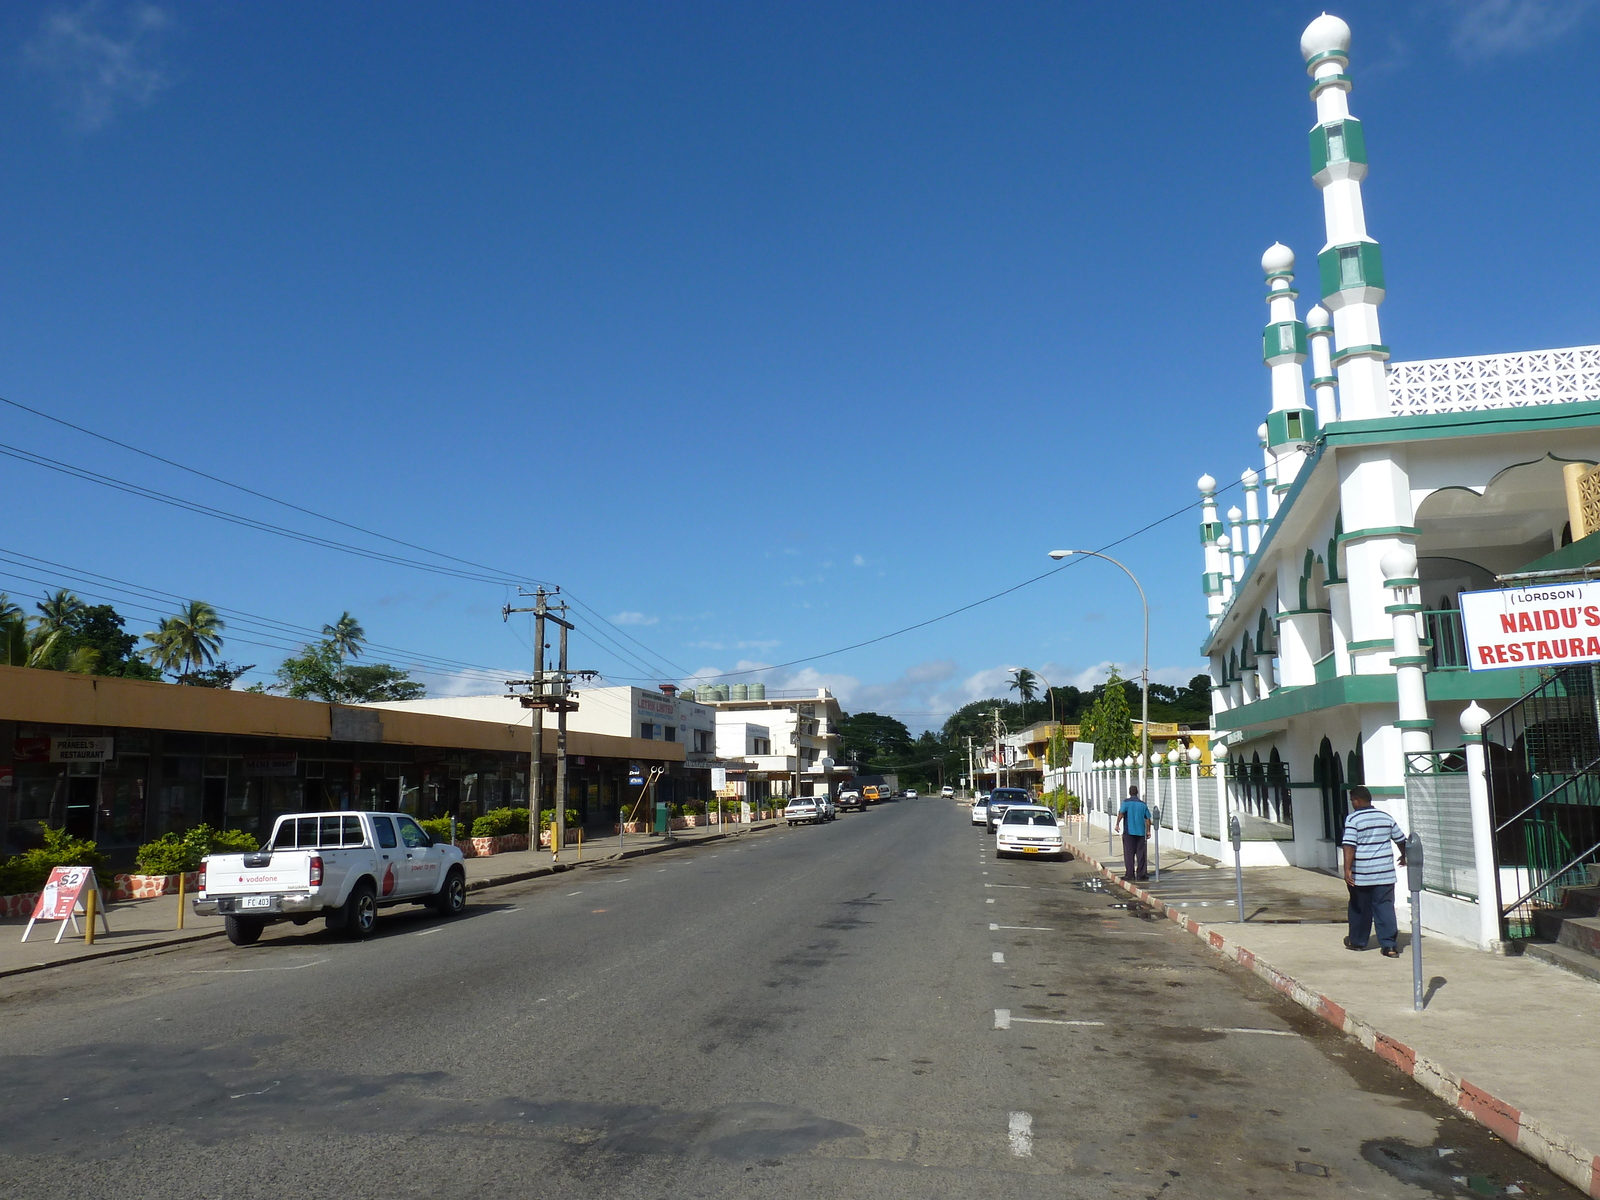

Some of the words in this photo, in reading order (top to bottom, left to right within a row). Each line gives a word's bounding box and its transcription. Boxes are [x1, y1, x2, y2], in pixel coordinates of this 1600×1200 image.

[1500, 606, 1600, 634] NAIDU'S
[57, 741, 95, 749] PRANEEL'S
[60, 751, 105, 759] RESTAURANT
[246, 875, 278, 883] vodafone
[247, 898, 256, 907] FC
[258, 898, 269, 906] 403
